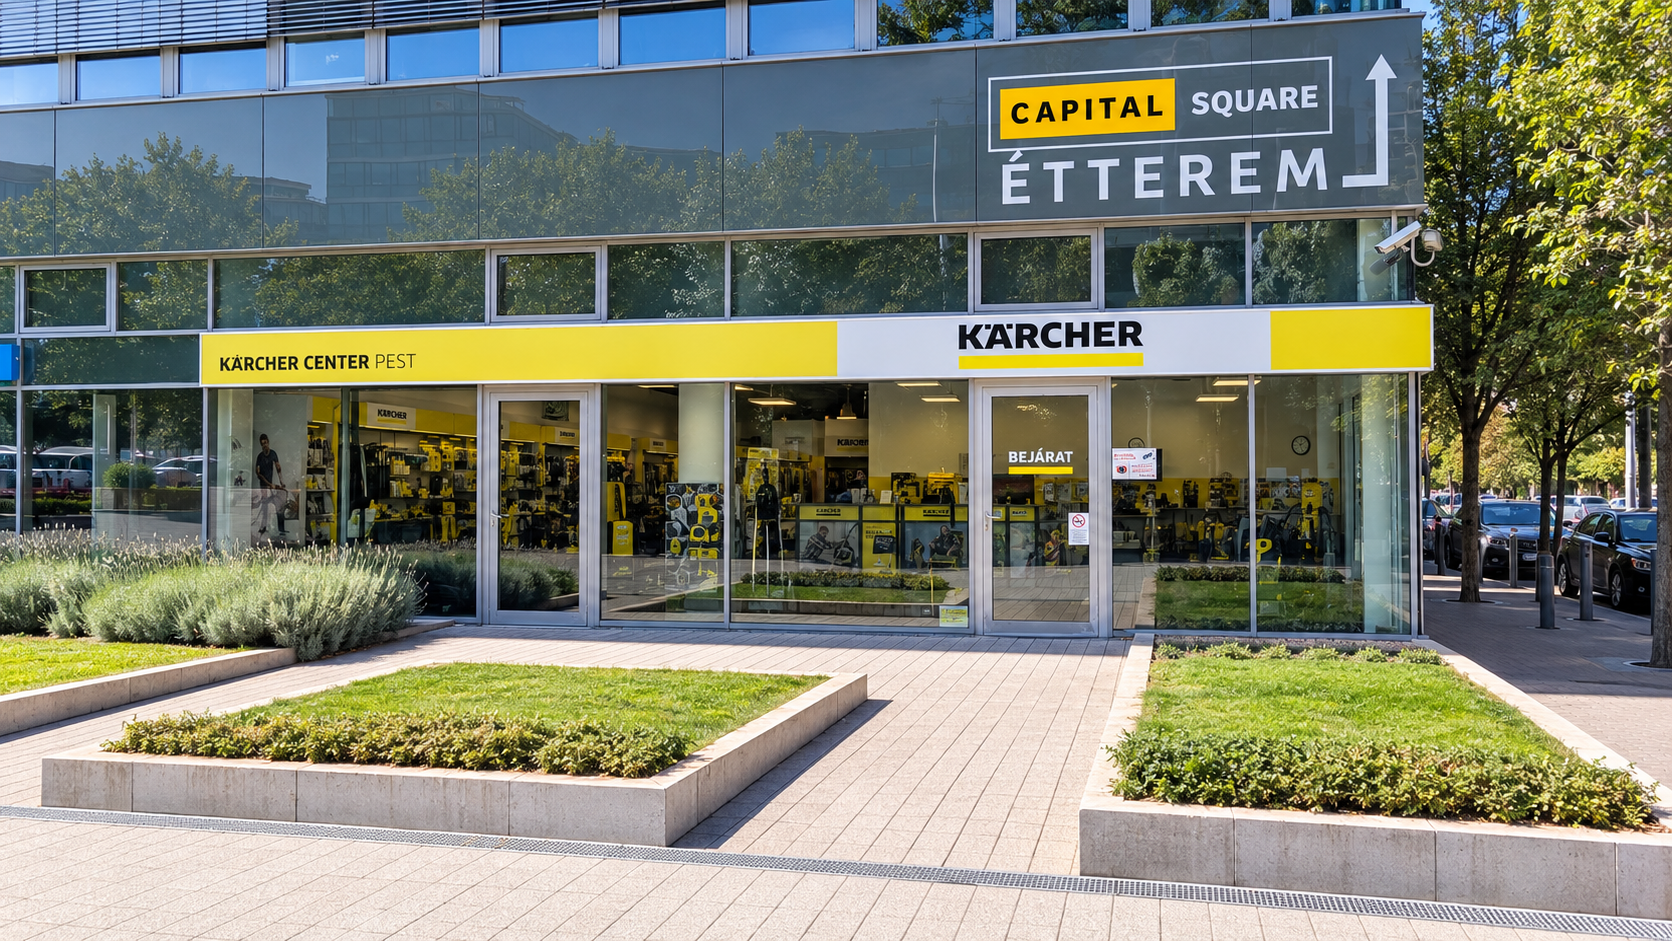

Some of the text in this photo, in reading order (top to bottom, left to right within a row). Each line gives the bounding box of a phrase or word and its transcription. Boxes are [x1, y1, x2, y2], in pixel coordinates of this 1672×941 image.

[1010, 84, 1319, 125] CAPITAL SQUARE
[1001, 148, 1328, 205] ÉTTEREM
[958, 320, 1144, 350] KÄRCHER
[219, 353, 417, 372] KÄRCHER CENTER PEST
[1008, 447, 1074, 464] BEJÁRAT
